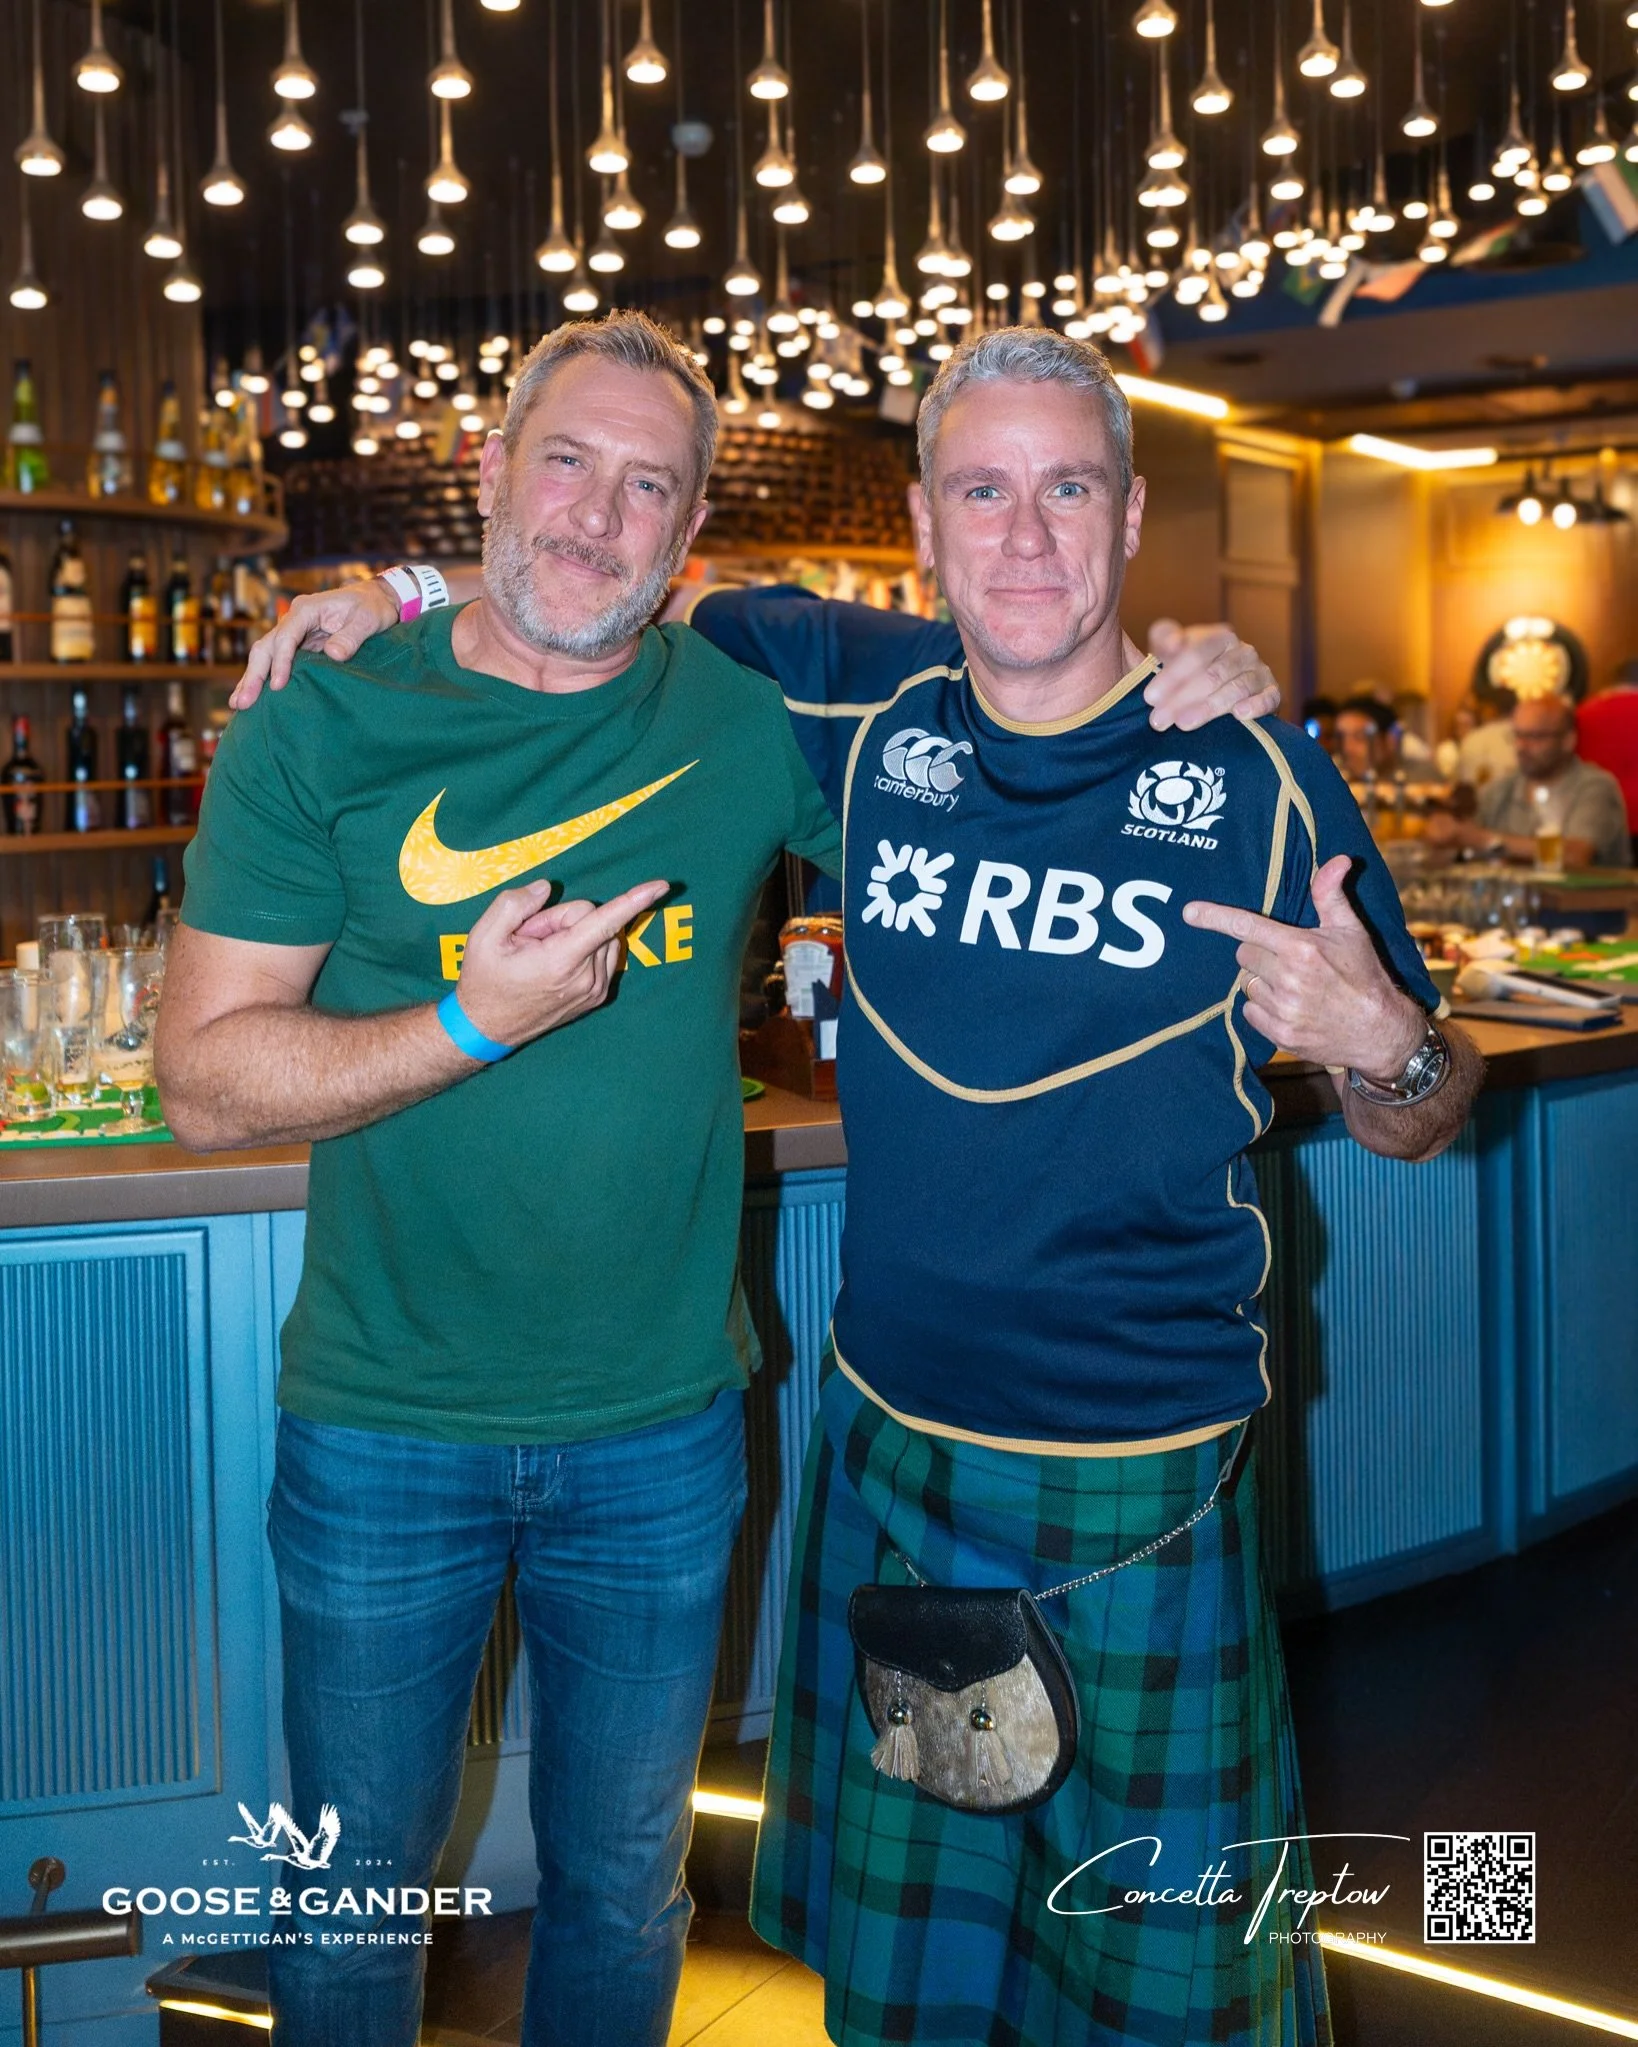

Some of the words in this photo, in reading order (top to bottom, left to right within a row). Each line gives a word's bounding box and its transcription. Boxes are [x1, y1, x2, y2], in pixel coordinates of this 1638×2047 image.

[1120, 823, 1219, 850] SCOTLAND
[439, 904, 694, 981] BKE
[959, 860, 1173, 968] RBS
